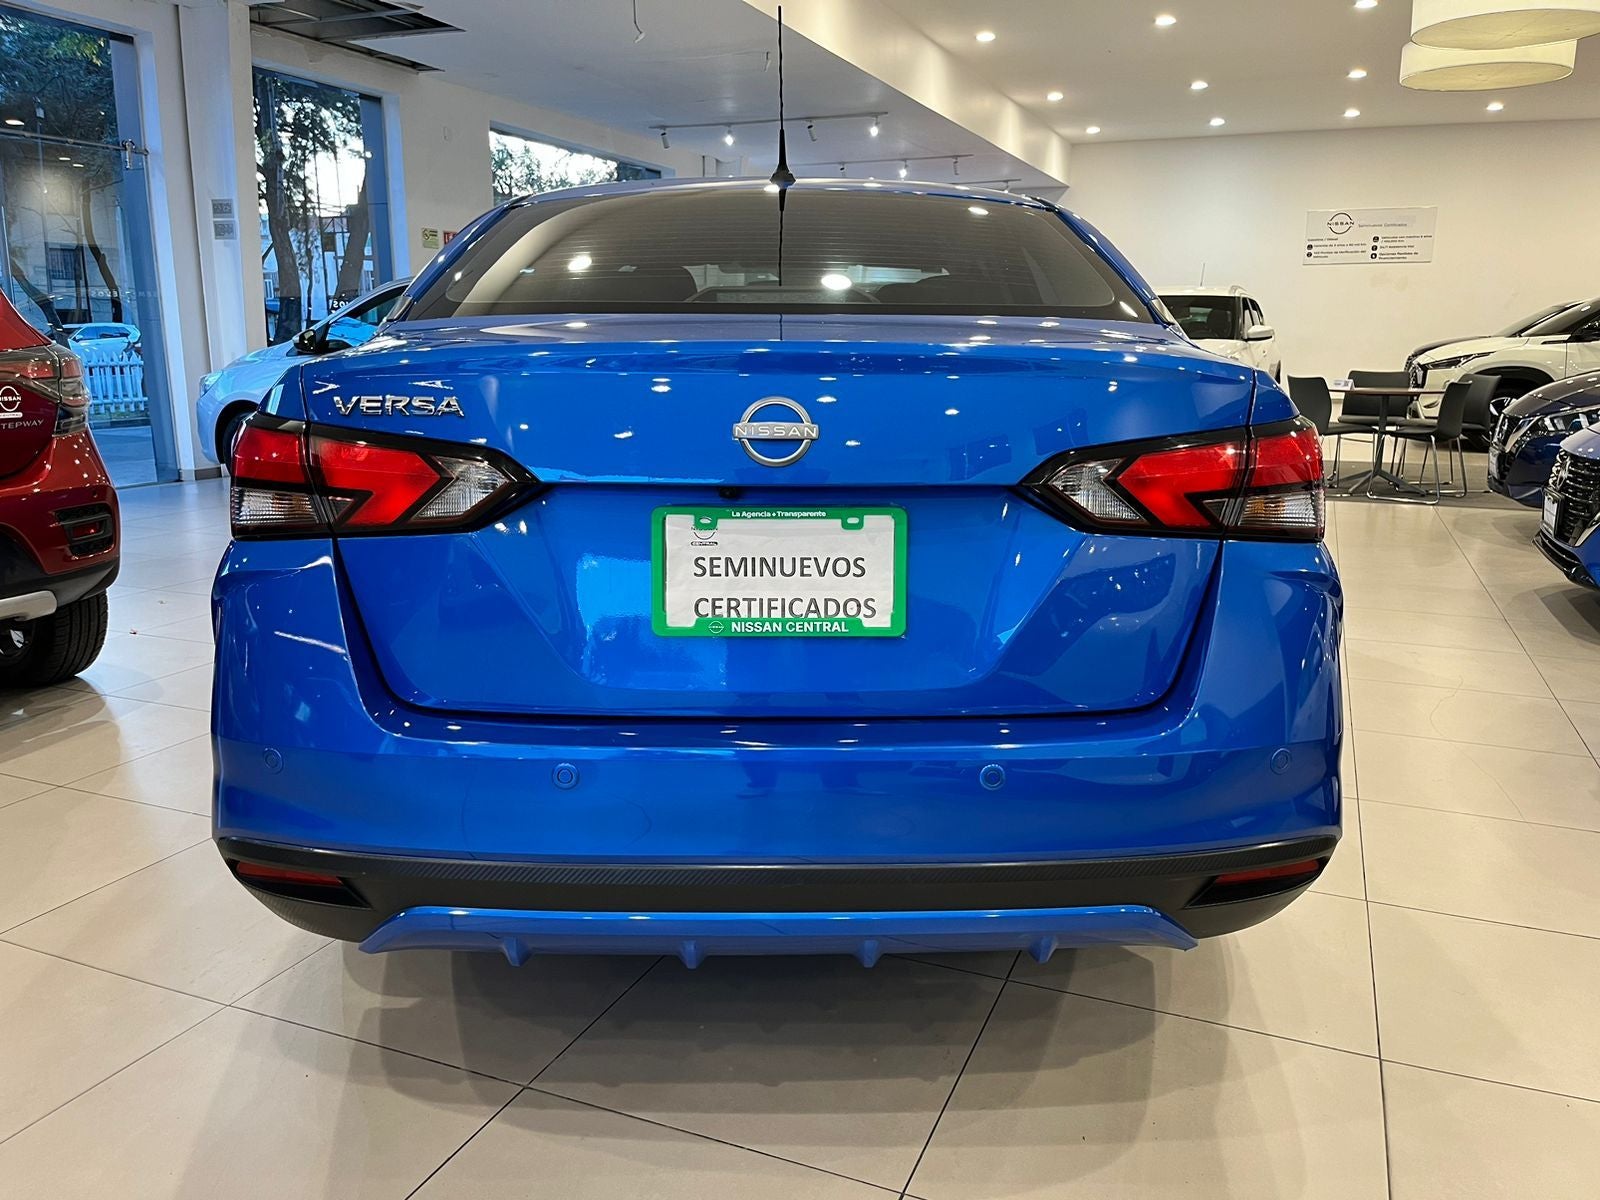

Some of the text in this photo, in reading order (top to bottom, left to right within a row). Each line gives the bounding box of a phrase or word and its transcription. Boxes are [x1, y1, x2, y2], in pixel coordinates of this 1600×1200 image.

[333, 394, 465, 417] VERSA
[735, 426, 817, 437] NISSAN
[741, 511, 771, 519] Agencia
[777, 510, 826, 519] Transparente
[693, 556, 866, 578] SEMINUEVOS
[693, 597, 877, 619] CERTIFICADOS
[731, 621, 849, 632] NISSAN CENTRAL
